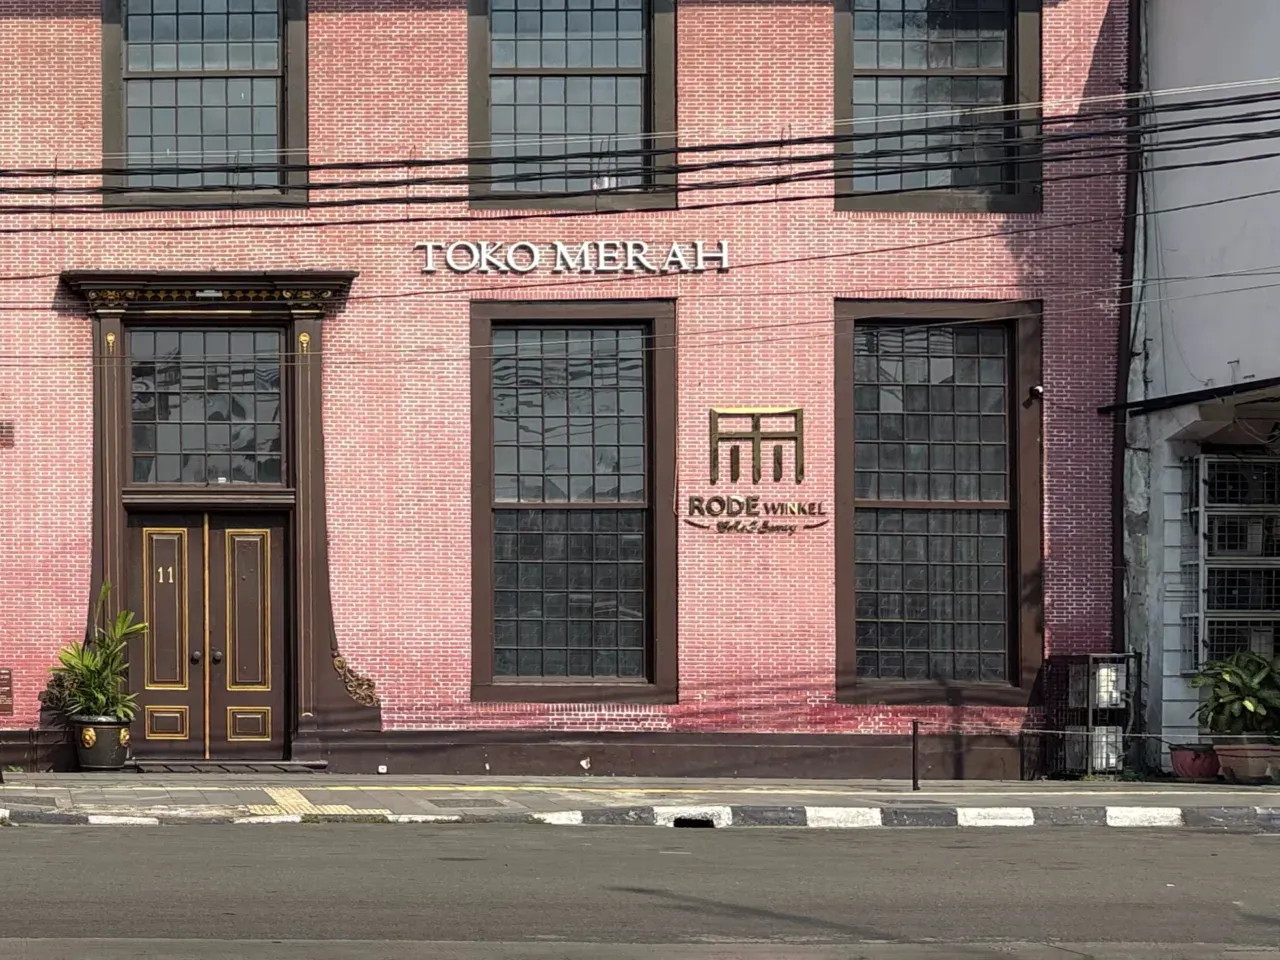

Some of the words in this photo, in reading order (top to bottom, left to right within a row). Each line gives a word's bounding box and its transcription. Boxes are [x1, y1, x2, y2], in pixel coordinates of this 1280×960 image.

[414, 240, 540, 273] TOKO
[552, 239, 730, 274] MERAH
[688, 495, 760, 516] RODE
[763, 502, 827, 515] WINKEL
[157, 566, 174, 583] 11
